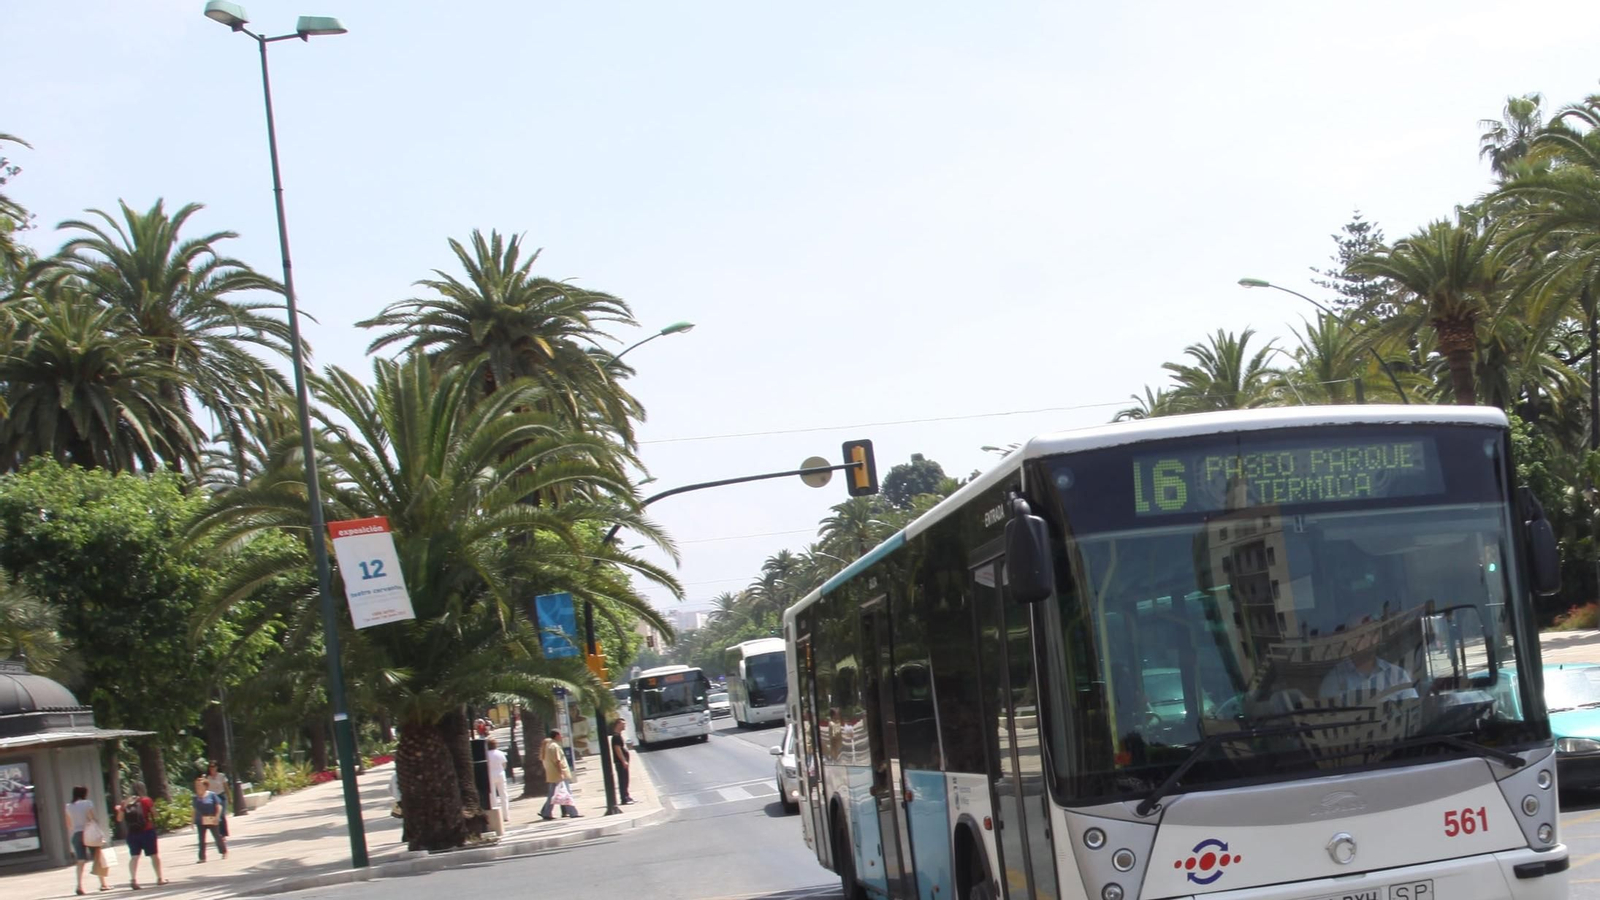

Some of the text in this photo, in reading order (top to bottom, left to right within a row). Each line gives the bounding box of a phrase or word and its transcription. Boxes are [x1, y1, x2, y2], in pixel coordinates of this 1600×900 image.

[1205, 443, 1414, 481] PASEO PARQUE
[1254, 472, 1372, 503] TERMICA
[338, 524, 385, 536] exposición
[359, 559, 387, 580] 12
[1443, 806, 1488, 837] 561
